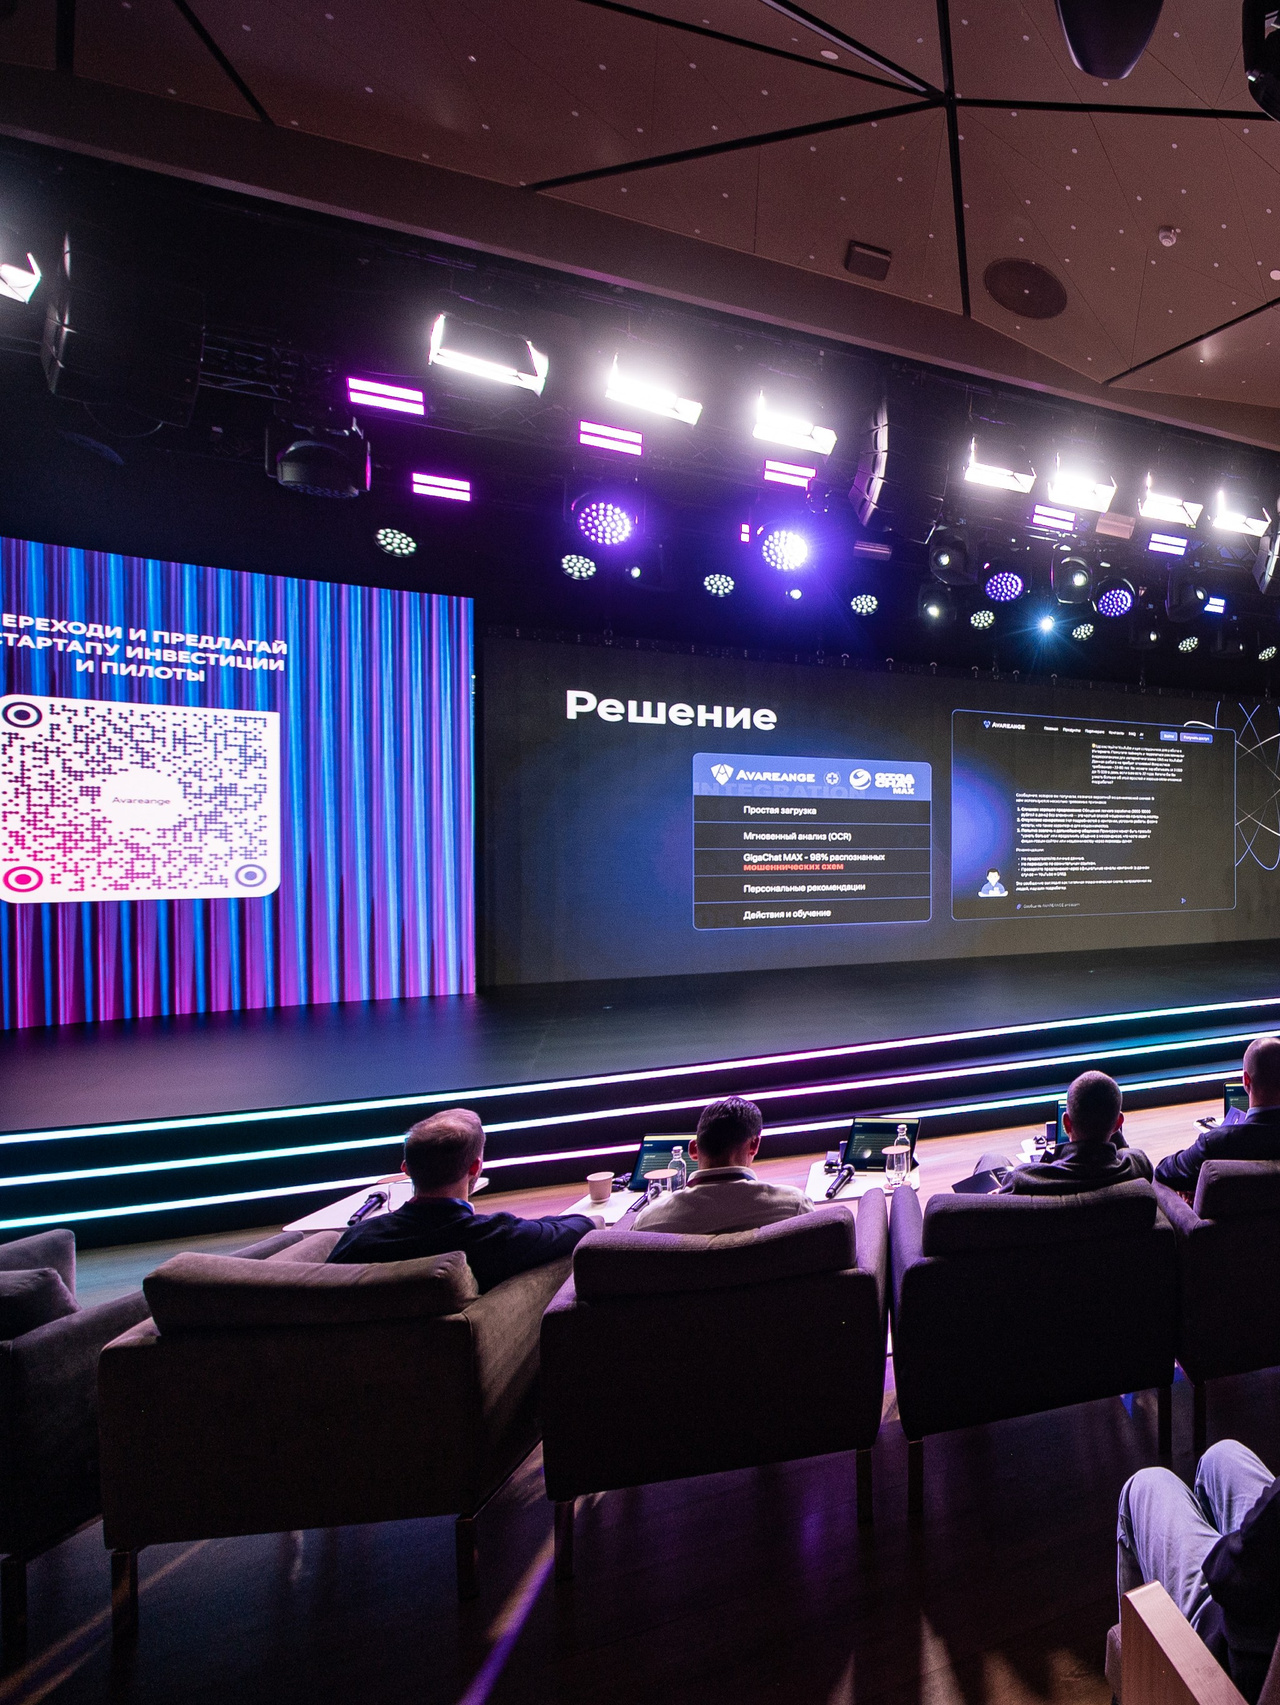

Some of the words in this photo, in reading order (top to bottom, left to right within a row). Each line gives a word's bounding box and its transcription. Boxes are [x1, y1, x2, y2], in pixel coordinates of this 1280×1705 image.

[129, 628, 147, 642] И
[152, 630, 288, 655] ПРЕДЛАГАЙ
[0, 632, 120, 656] ТАРТАПУ
[126, 645, 285, 671] ИНВЕСТИЦИИ
[76, 659, 94, 673] И
[101, 661, 205, 682] ПИЛОТЫ
[566, 690, 778, 731] Решение
[735, 769, 816, 783] AVAREANGE
[892, 787, 915, 795] MAX
[112, 797, 171, 806] Avareange
[743, 805, 780, 816] Простая
[780, 808, 817, 817] загрузка
[743, 831, 797, 841] Мгновенный
[797, 833, 827, 842] анализ
[828, 832, 852, 842] (OCR)
[743, 853, 782, 864] GigaChat
[782, 853, 804, 862] MAX
[809, 853, 829, 862] 98%
[829, 855, 886, 863] распознанных
[821, 862, 845, 871] схем
[743, 884, 806, 894] Персональные
[806, 883, 866, 893] рекомендации
[743, 909, 785, 921] Действия
[792, 908, 832, 919] обучение
